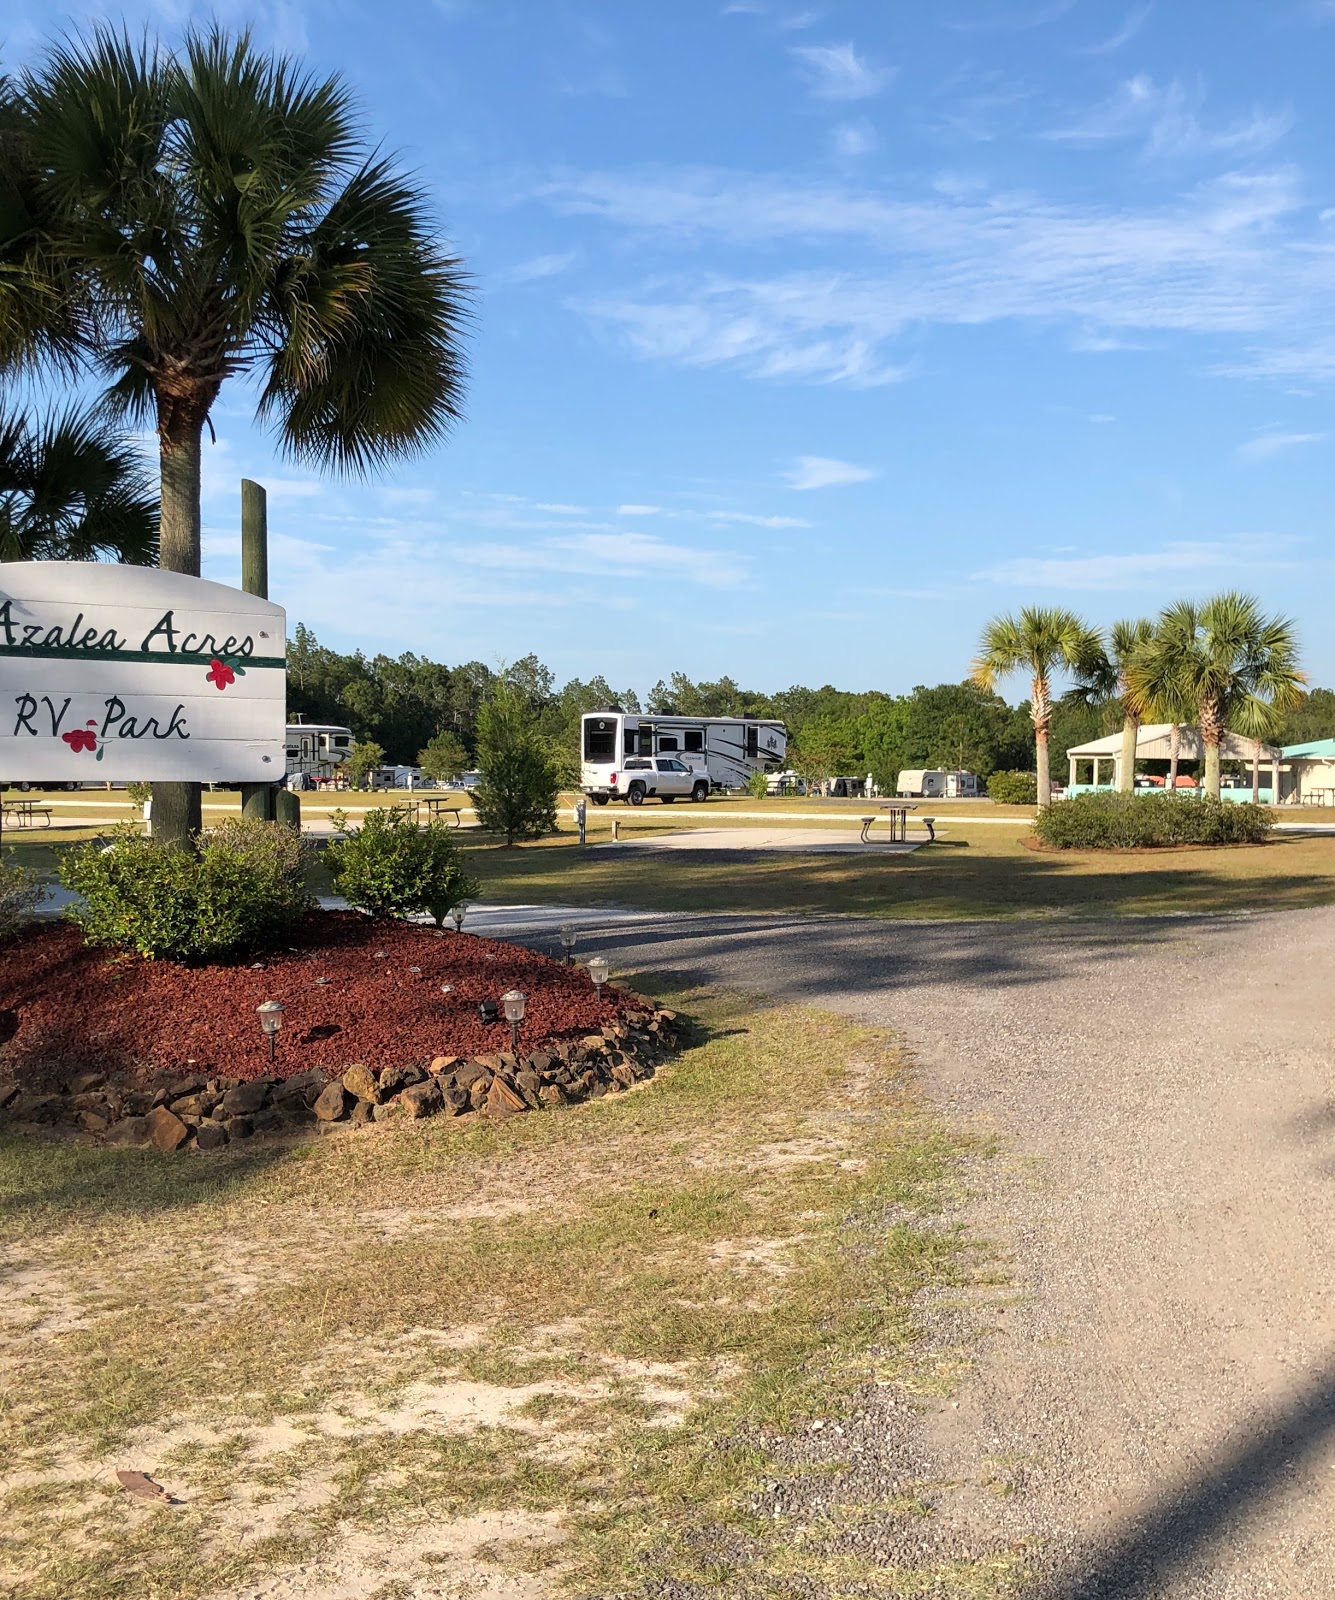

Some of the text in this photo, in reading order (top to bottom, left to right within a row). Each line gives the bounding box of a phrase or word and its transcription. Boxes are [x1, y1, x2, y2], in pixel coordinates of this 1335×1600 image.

[141, 610, 255, 657] Acres
[14, 692, 191, 740] RV Park
